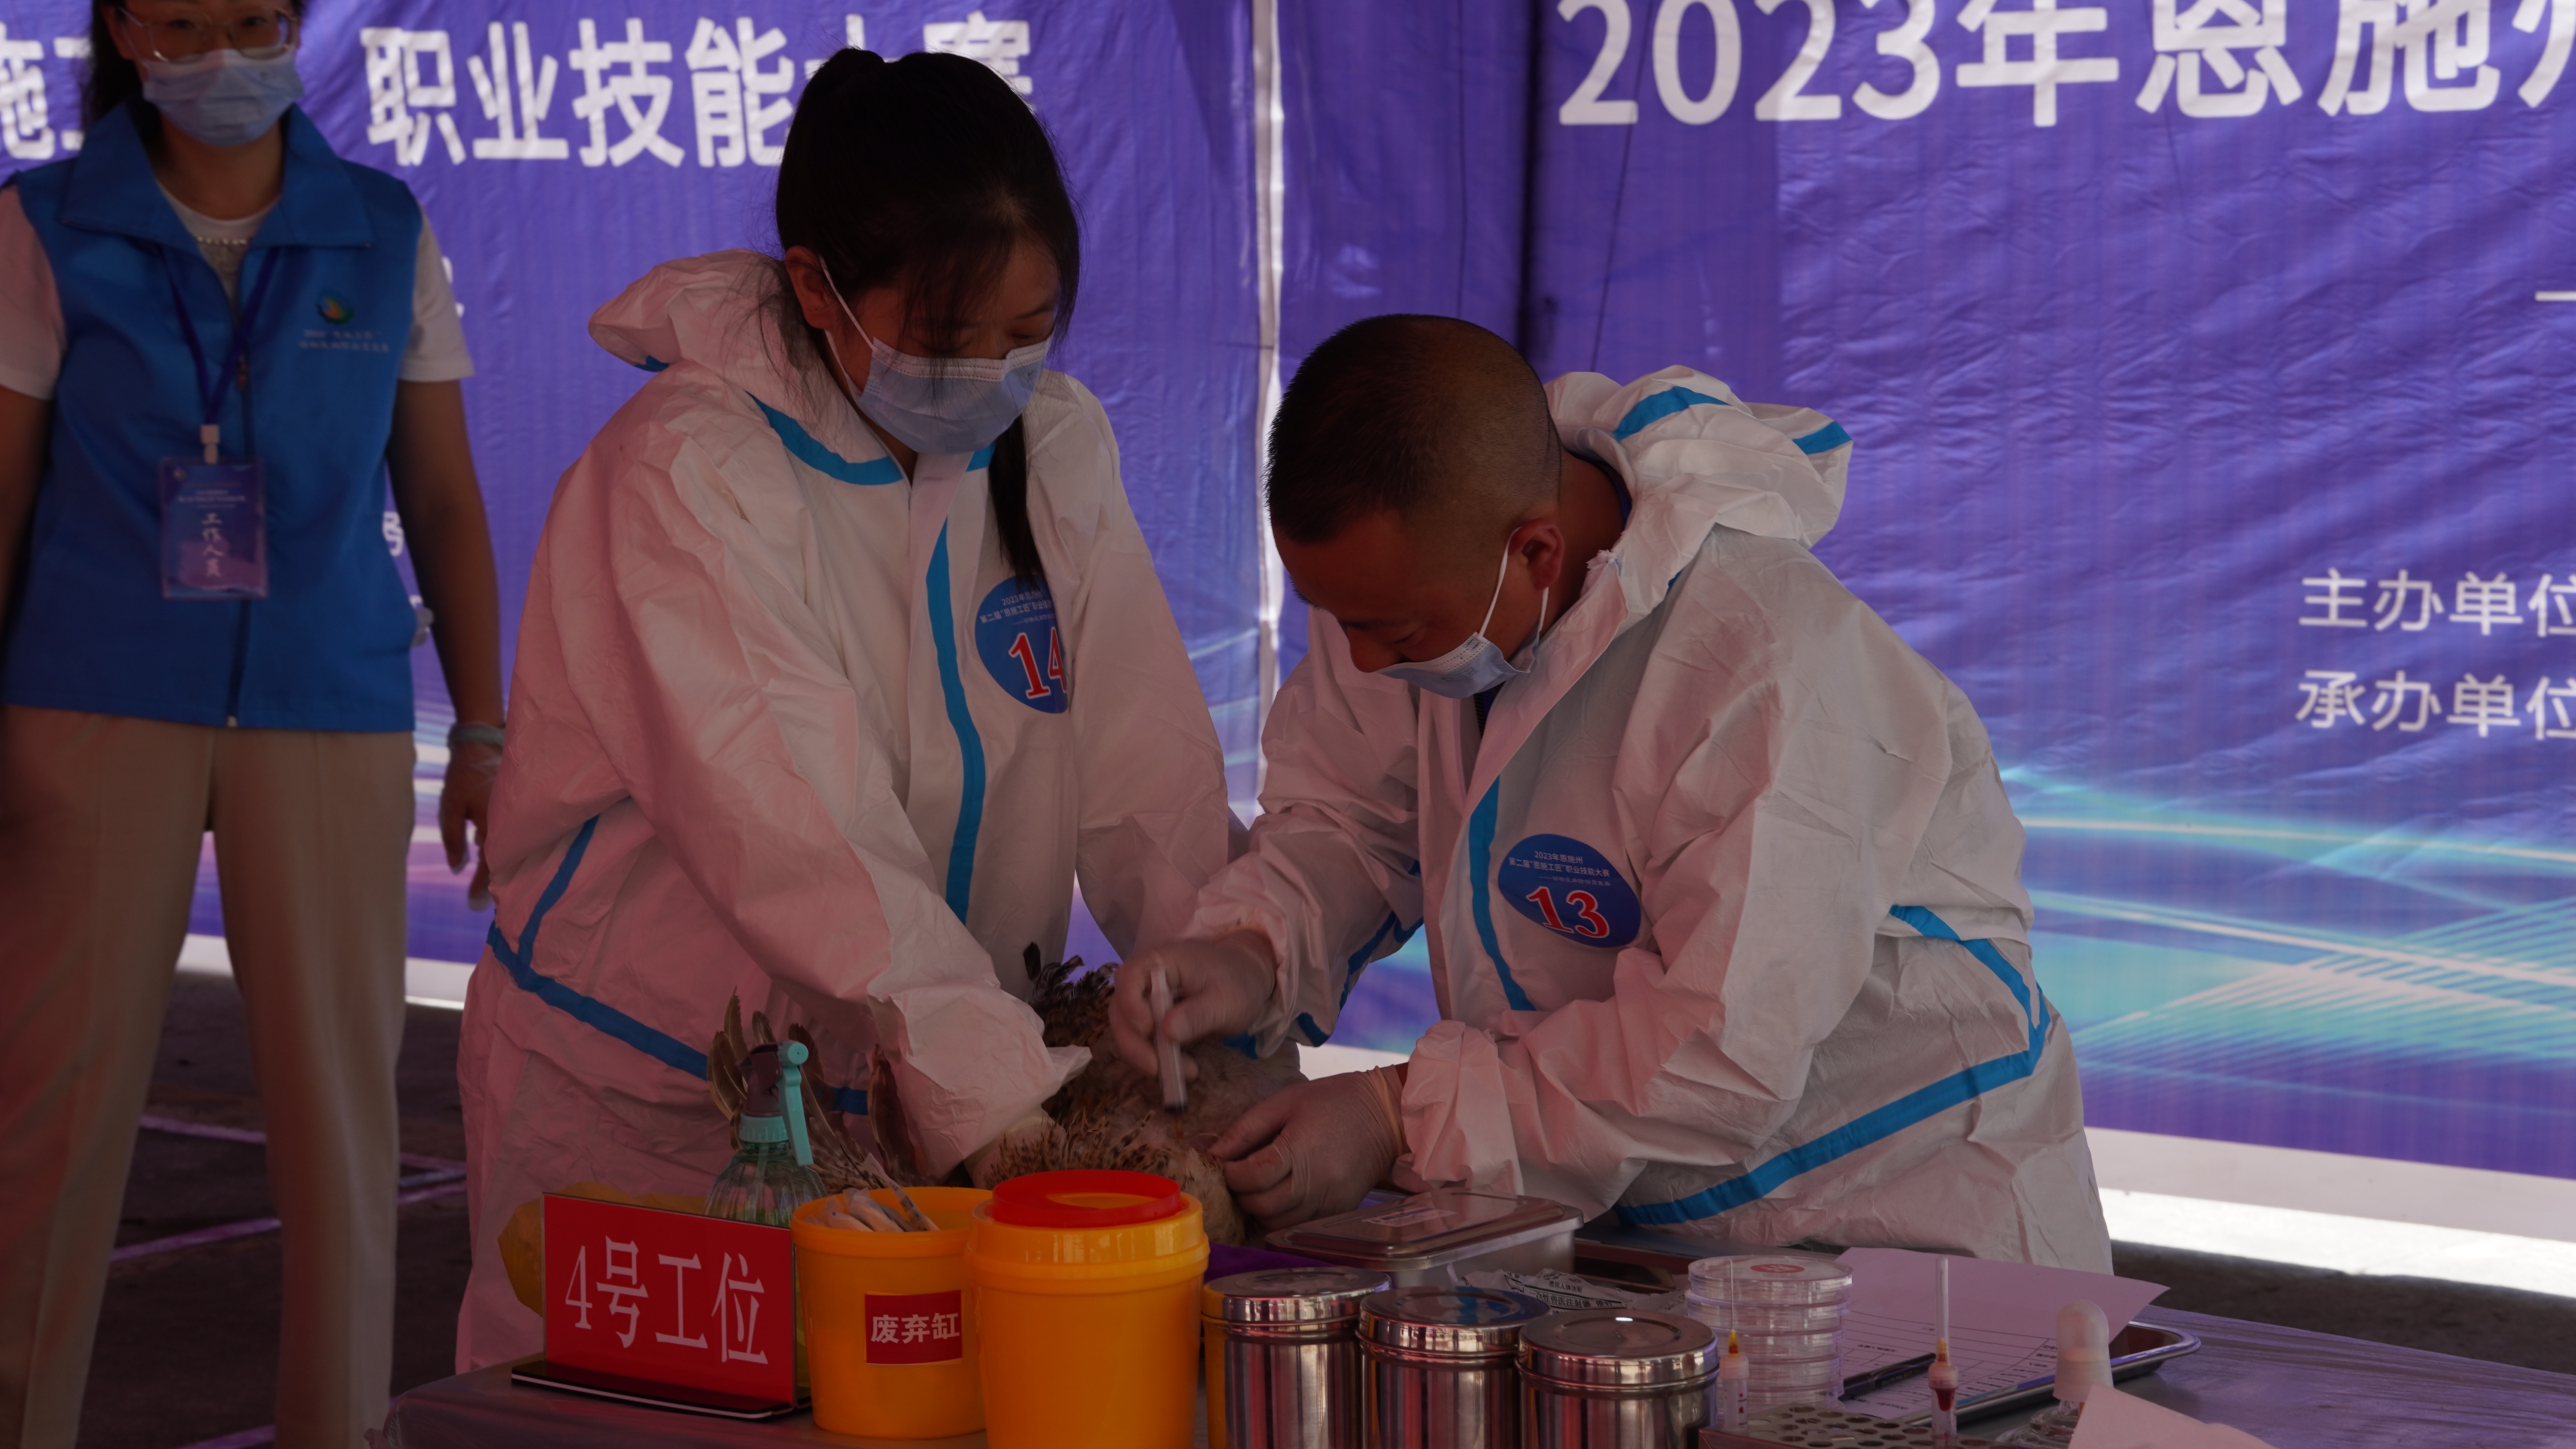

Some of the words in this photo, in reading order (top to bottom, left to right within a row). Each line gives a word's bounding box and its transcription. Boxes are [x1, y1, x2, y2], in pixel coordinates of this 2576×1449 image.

[360, 10, 1033, 168] 职业技能
[2299, 567, 2576, 637] 主办单位
[1008, 627, 1067, 699] 14
[2295, 670, 2576, 740] 承办单位
[1534, 851, 1583, 864] 2023年恩施州
[1525, 886, 1610, 939] 13
[565, 1235, 768, 1364] 4号工位
[870, 1313, 960, 1344] 废弃缸
